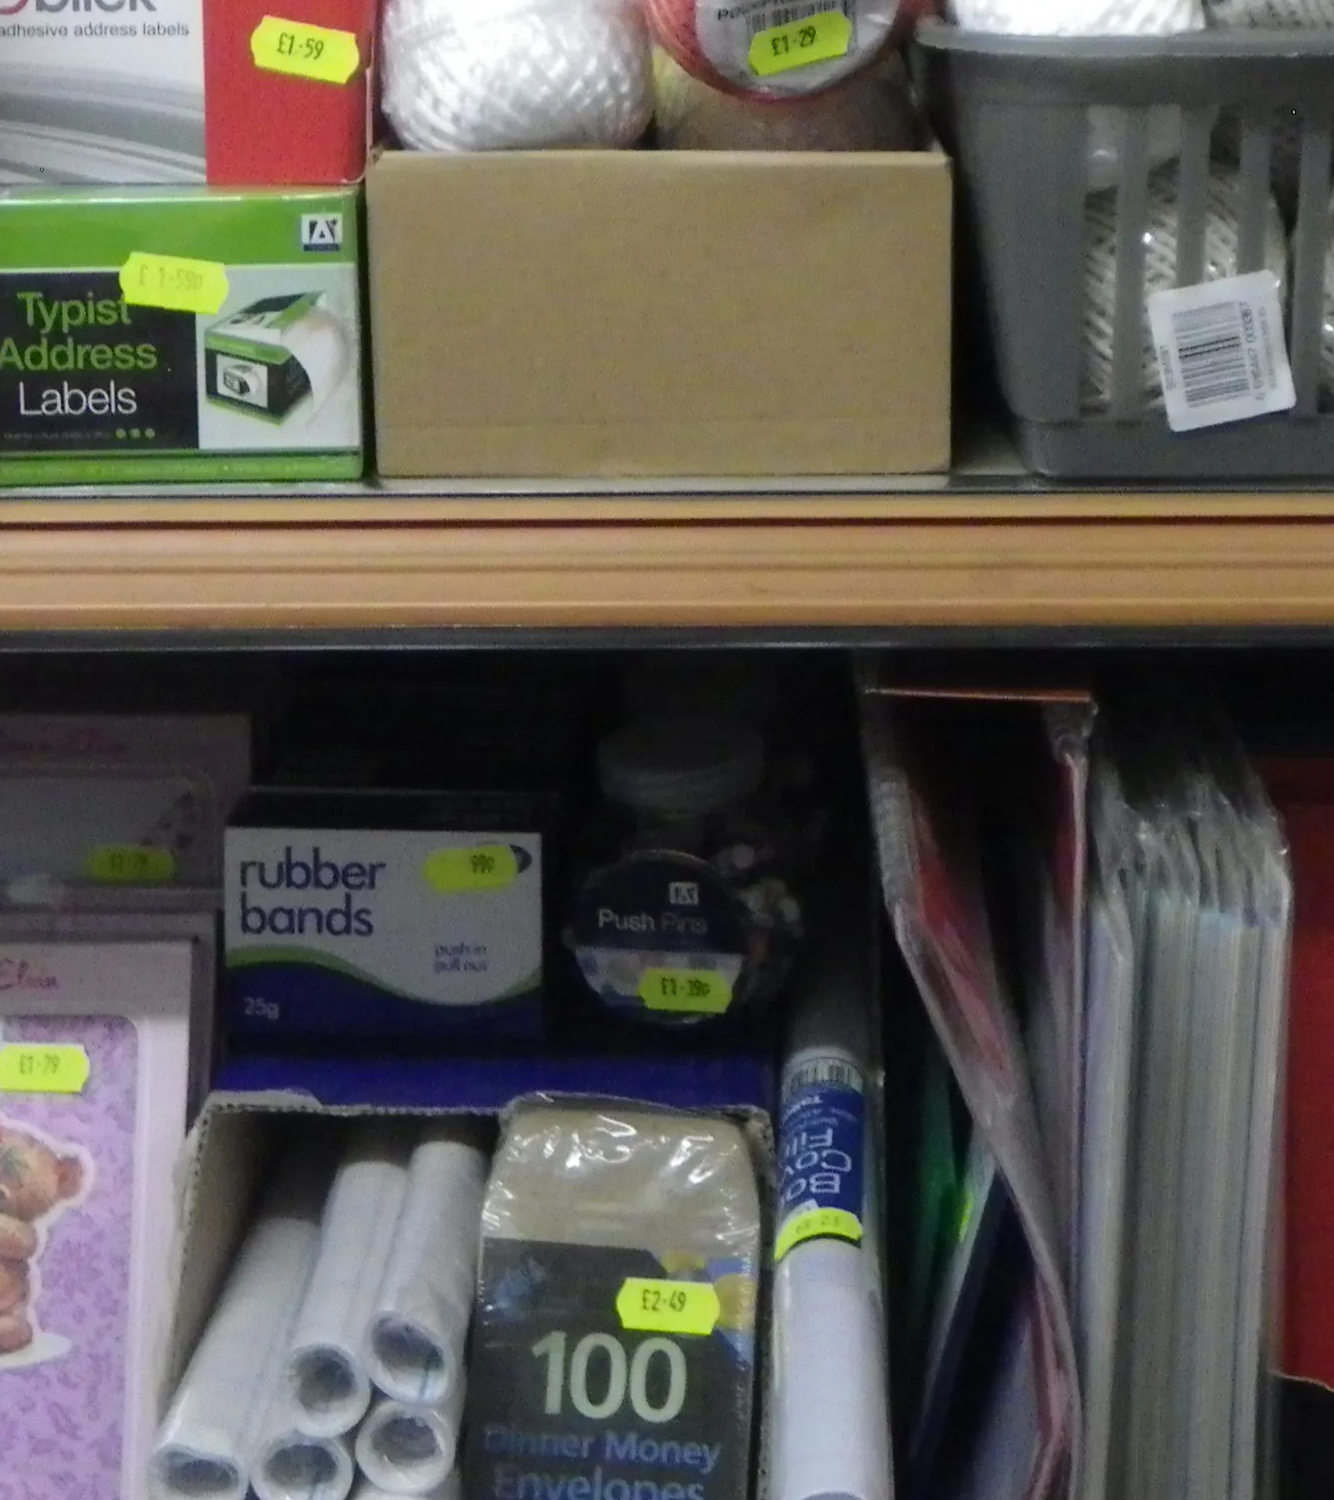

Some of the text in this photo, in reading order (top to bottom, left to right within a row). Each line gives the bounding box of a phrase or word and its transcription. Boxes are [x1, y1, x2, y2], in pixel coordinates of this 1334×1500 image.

[73, 21, 138, 38] address
[142, 21, 190, 37] labels
[16, 290, 133, 334] Typist
[19, 380, 138, 417] Labels
[240, 846, 386, 891] rubber
[240, 891, 374, 937] bands
[598, 909, 656, 932] Push
[531, 1329, 687, 1424] 100
[483, 1422, 722, 1473] Dinner Money
